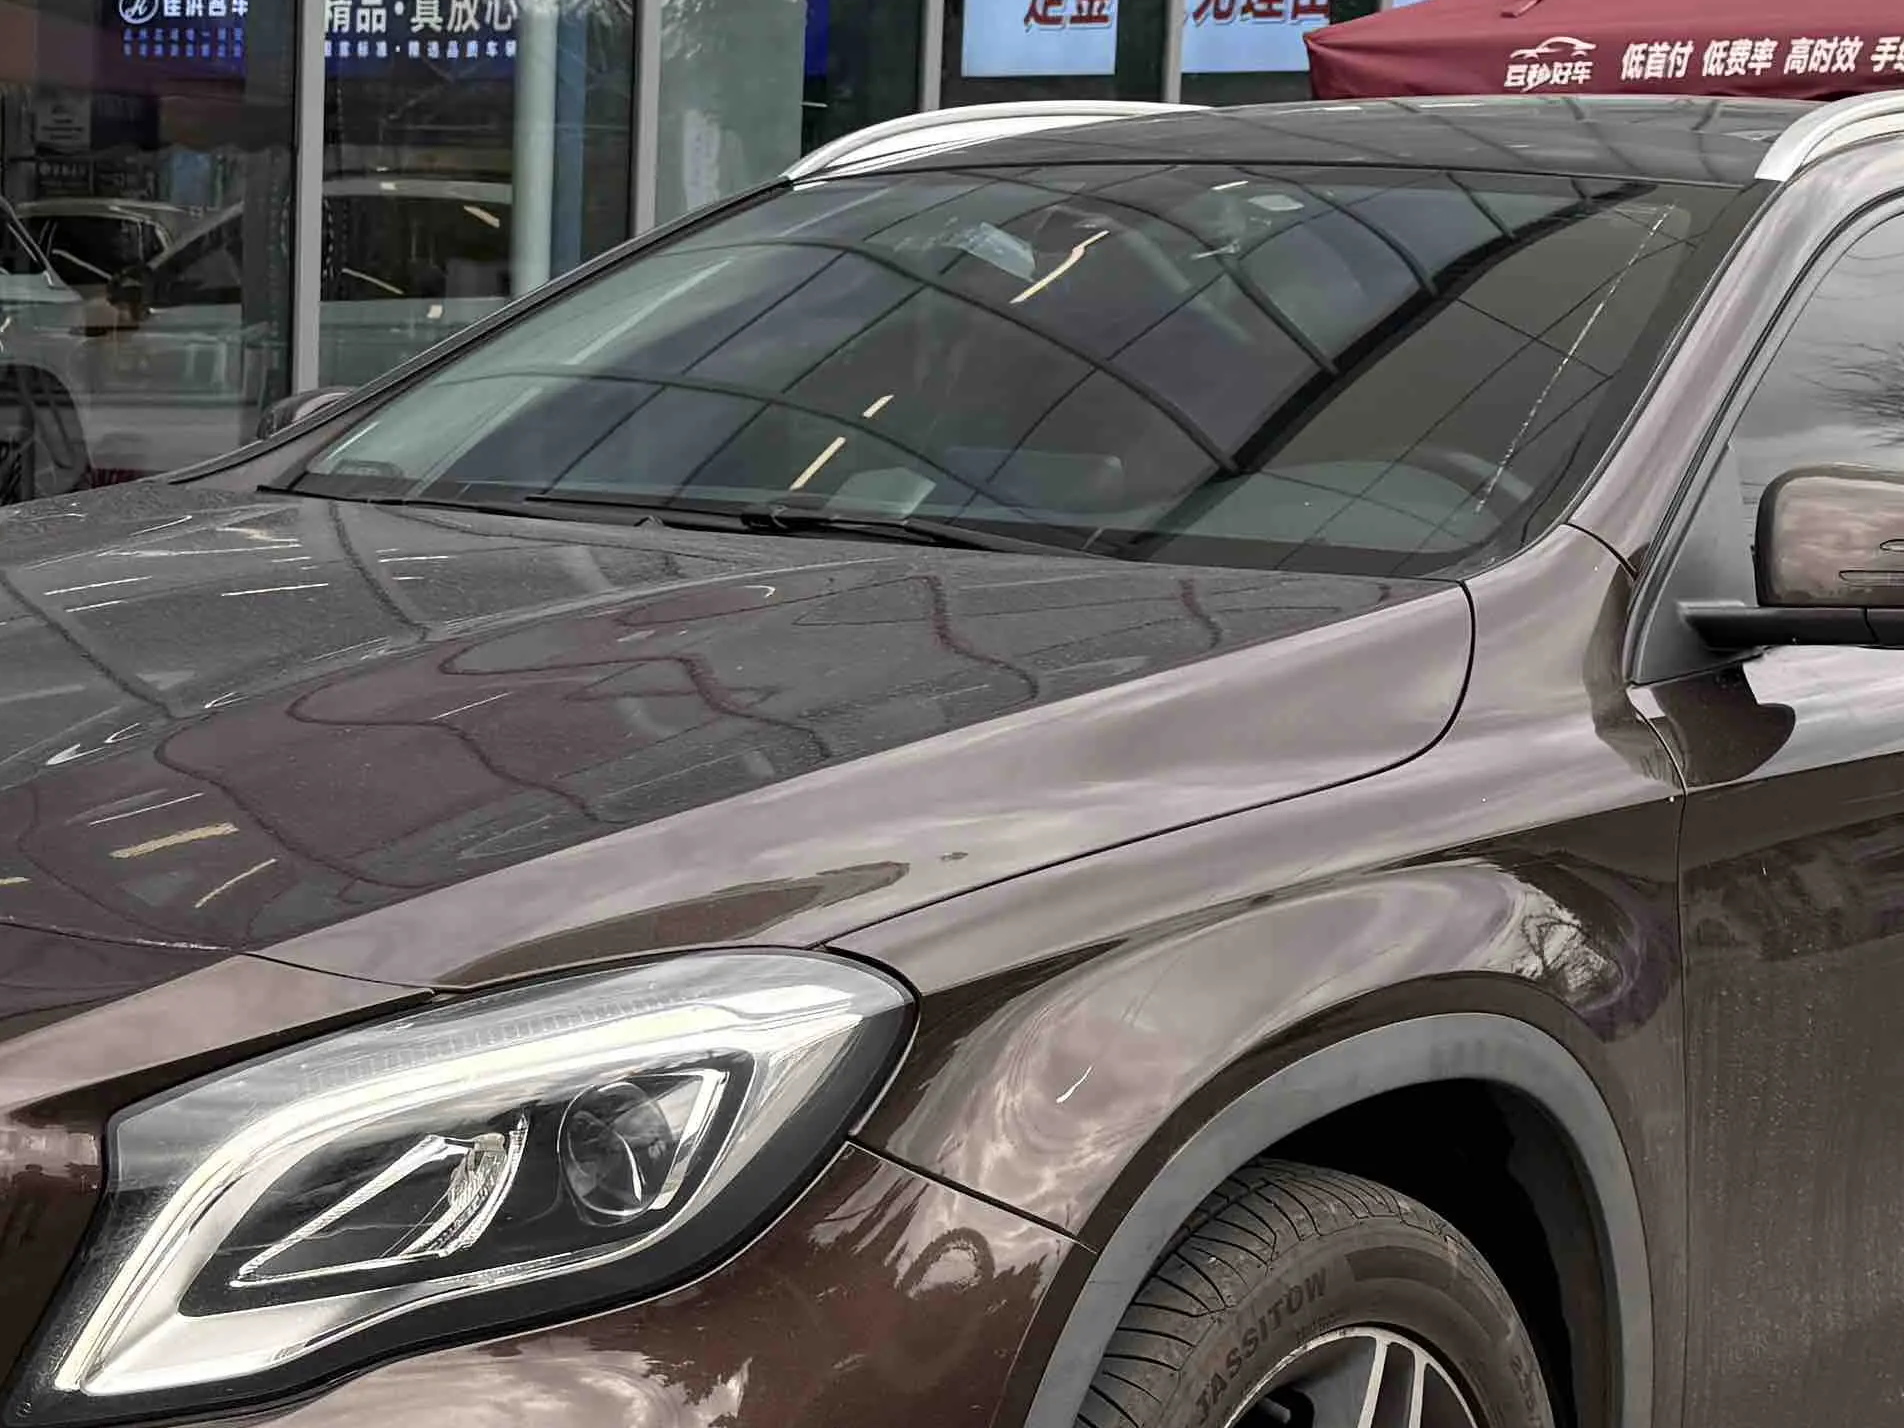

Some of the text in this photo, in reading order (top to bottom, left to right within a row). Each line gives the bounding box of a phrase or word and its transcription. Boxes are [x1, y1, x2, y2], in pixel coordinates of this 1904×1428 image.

[1621, 40, 1694, 81] 低首付
[1702, 38, 1778, 77] 低费率
[1784, 36, 1863, 75] 高时效
